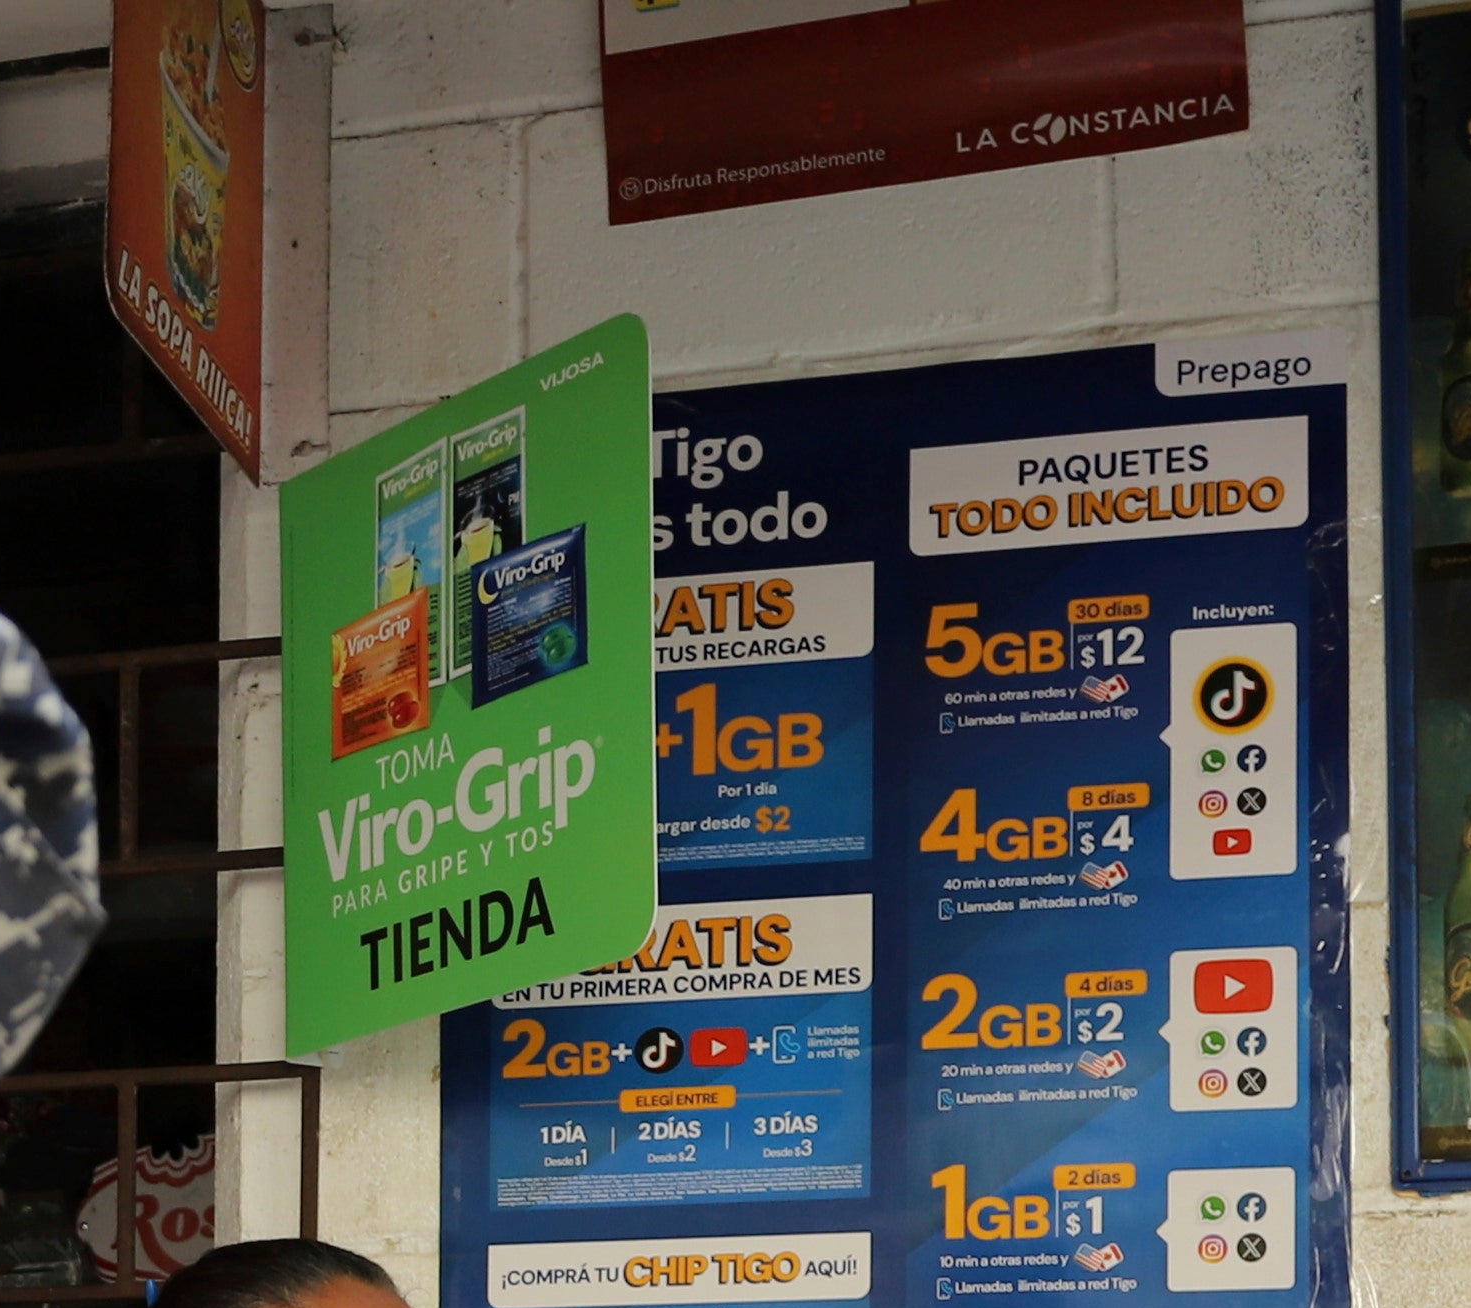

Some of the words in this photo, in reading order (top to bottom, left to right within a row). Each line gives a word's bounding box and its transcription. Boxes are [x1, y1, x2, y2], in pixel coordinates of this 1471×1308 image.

[956, 127, 998, 154] LA
[644, 168, 712, 195] Disfruta
[716, 146, 887, 188] Responsablemente
[118, 248, 142, 309] LA
[144, 284, 193, 373] SOPA
[196, 346, 252, 448] RIIICA!
[539, 352, 604, 391] VIJOSA
[1177, 356, 1313, 388] Prepago
[1018, 444, 1210, 486] PAQUETES
[685, 490, 828, 546] todo
[930, 494, 1059, 538] TODO
[1067, 475, 1286, 528] INCLUIDO
[493, 549, 566, 589] Viro-Grip
[654, 578, 795, 638] ATIS
[1075, 603, 1103, 619] 30
[1104, 601, 1143, 617] días
[1192, 603, 1275, 622] Incluyen:
[347, 615, 411, 656] Viro-Grip
[703, 635, 827, 662] RECARGAS
[924, 603, 1067, 678] 5GB
[999, 689, 1030, 702] otras
[1032, 686, 1067, 700] redes
[957, 712, 1016, 728] Llamadas
[1114, 705, 1139, 720] Tigo
[375, 733, 455, 789] TOMA
[317, 725, 596, 883] Viro-Grip
[718, 785, 743, 799] Por
[754, 782, 778, 796] día
[1082, 792, 1093, 806] 8
[1098, 789, 1136, 805] días
[700, 814, 751, 831] desde
[755, 806, 792, 833] $2
[920, 788, 1070, 862] 4GB
[332, 879, 388, 919] PARA
[398, 850, 468, 895] GRIPE
[480, 841, 493, 867] Y
[505, 821, 554, 857] TOS
[997, 875, 1030, 888] otras
[1031, 873, 1066, 886] redes
[957, 899, 1015, 914] Llamadas
[1112, 892, 1139, 907] Tigo
[360, 877, 555, 991] TIENDA
[539, 981, 564, 999] TU
[570, 976, 667, 999] PRIMERA
[673, 972, 770, 993] COMPRA
[778, 969, 808, 988] DE
[814, 966, 861, 985] MES
[1079, 978, 1091, 994] 4
[1096, 977, 1134, 992] días
[921, 973, 1063, 1050] 2GB
[995, 1062, 1027, 1075] otras
[1028, 1060, 1063, 1074] redes
[676, 1093, 719, 1106] ENTRE
[956, 1090, 1014, 1105] Llamadas
[1112, 1085, 1138, 1100] Tigo
[653, 1116, 702, 1140] DÍAS
[769, 1111, 819, 1134] DÍAS
[1068, 1171, 1078, 1186] 2
[1083, 1169, 1121, 1185] días
[931, 1164, 1051, 1240] 1GB
[501, 1263, 591, 1290] ¡COMPRÁ
[595, 1267, 619, 1283] TU
[623, 1255, 708, 1287] CHIP
[712, 1251, 801, 1285] TIGO
[804, 1254, 858, 1277] AQUÍ!
[990, 1254, 1022, 1267] otras
[1023, 1252, 1059, 1266] redes
[955, 1280, 1013, 1295] Llamadas
[1111, 1276, 1138, 1292] Tigo
